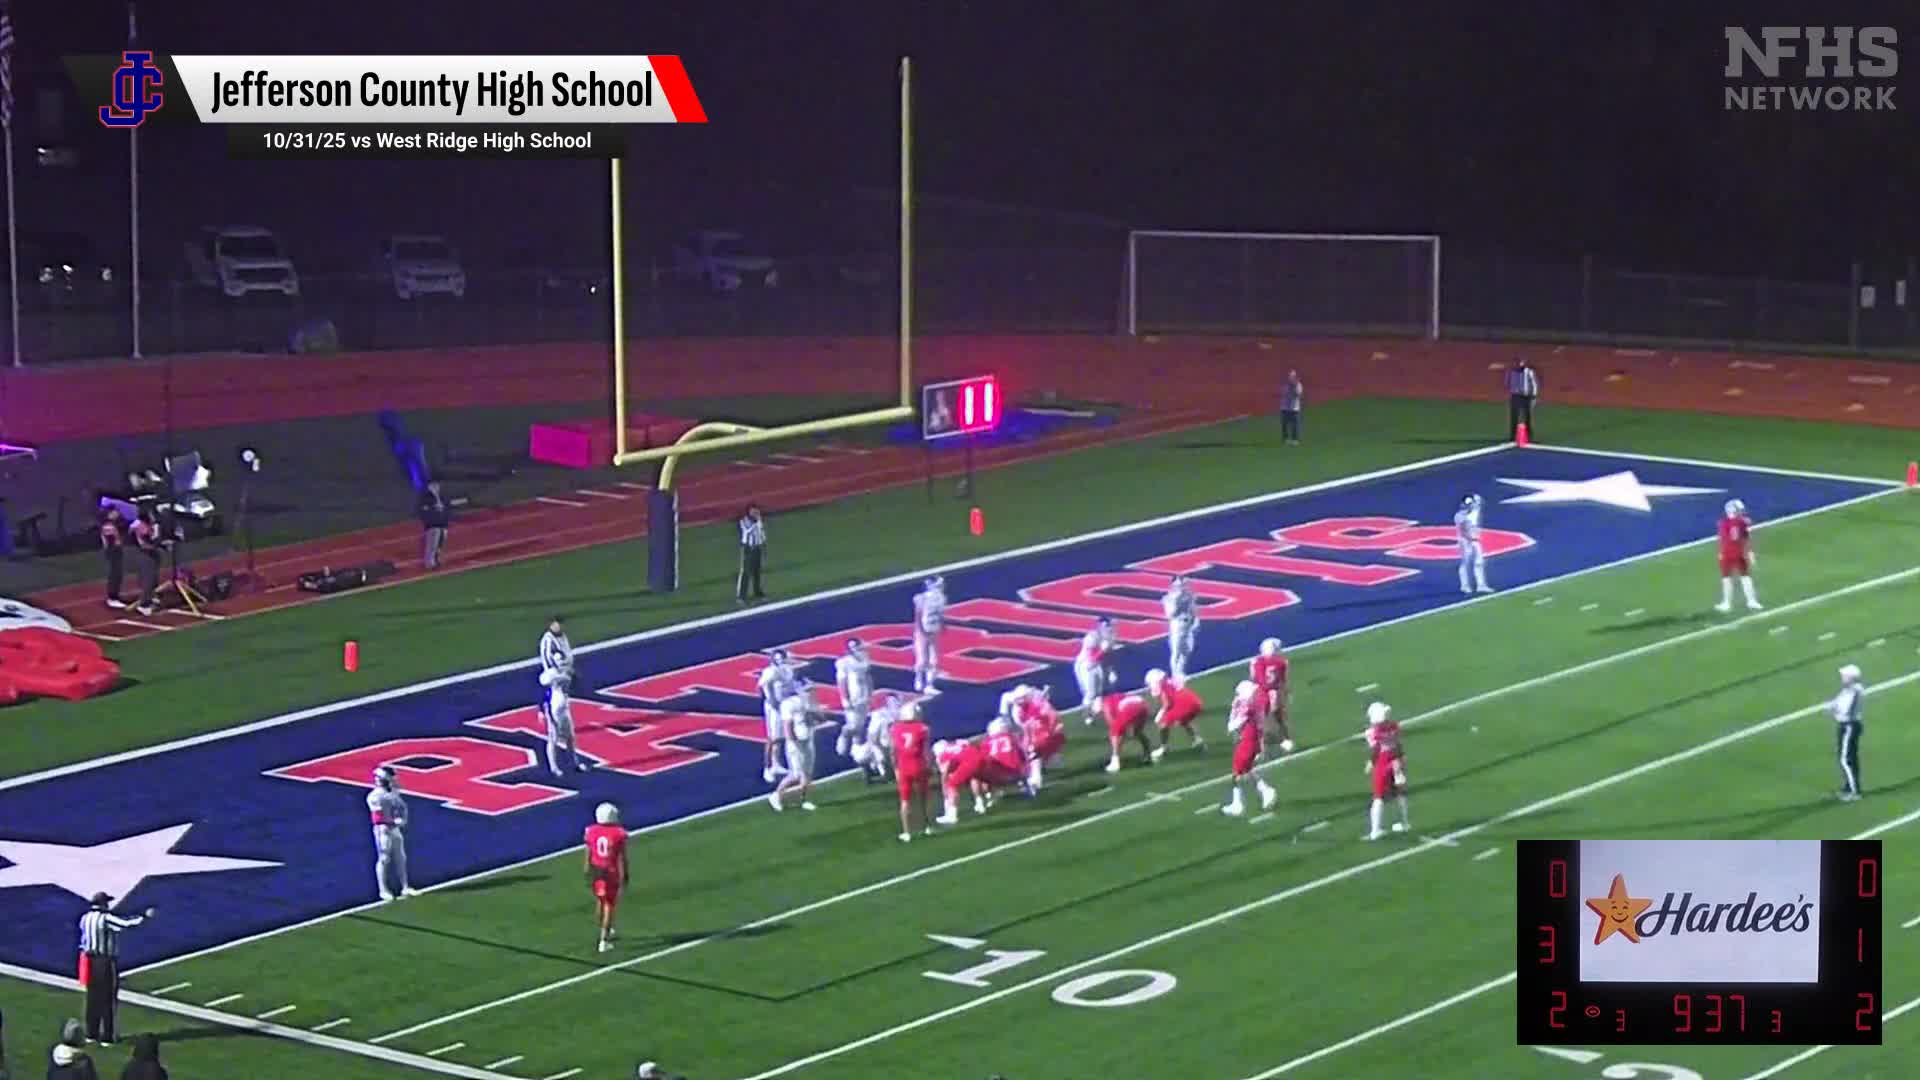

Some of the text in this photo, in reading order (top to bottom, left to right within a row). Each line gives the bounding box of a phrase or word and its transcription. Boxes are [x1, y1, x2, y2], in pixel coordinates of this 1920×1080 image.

[964, 382, 994, 425] 11
[262, 516, 1536, 816] PATRIOTS
[1264, 665, 1277, 684] 5
[902, 732, 913, 750] 7
[988, 734, 1012, 757] 73
[596, 836, 609, 857] 0
[1634, 891, 1815, 938] Hardee's
[1539, 925, 1556, 963] 3
[921, 949, 1177, 1008] 10
[1549, 991, 1567, 1028] 2
[1855, 992, 1874, 1031] 2
